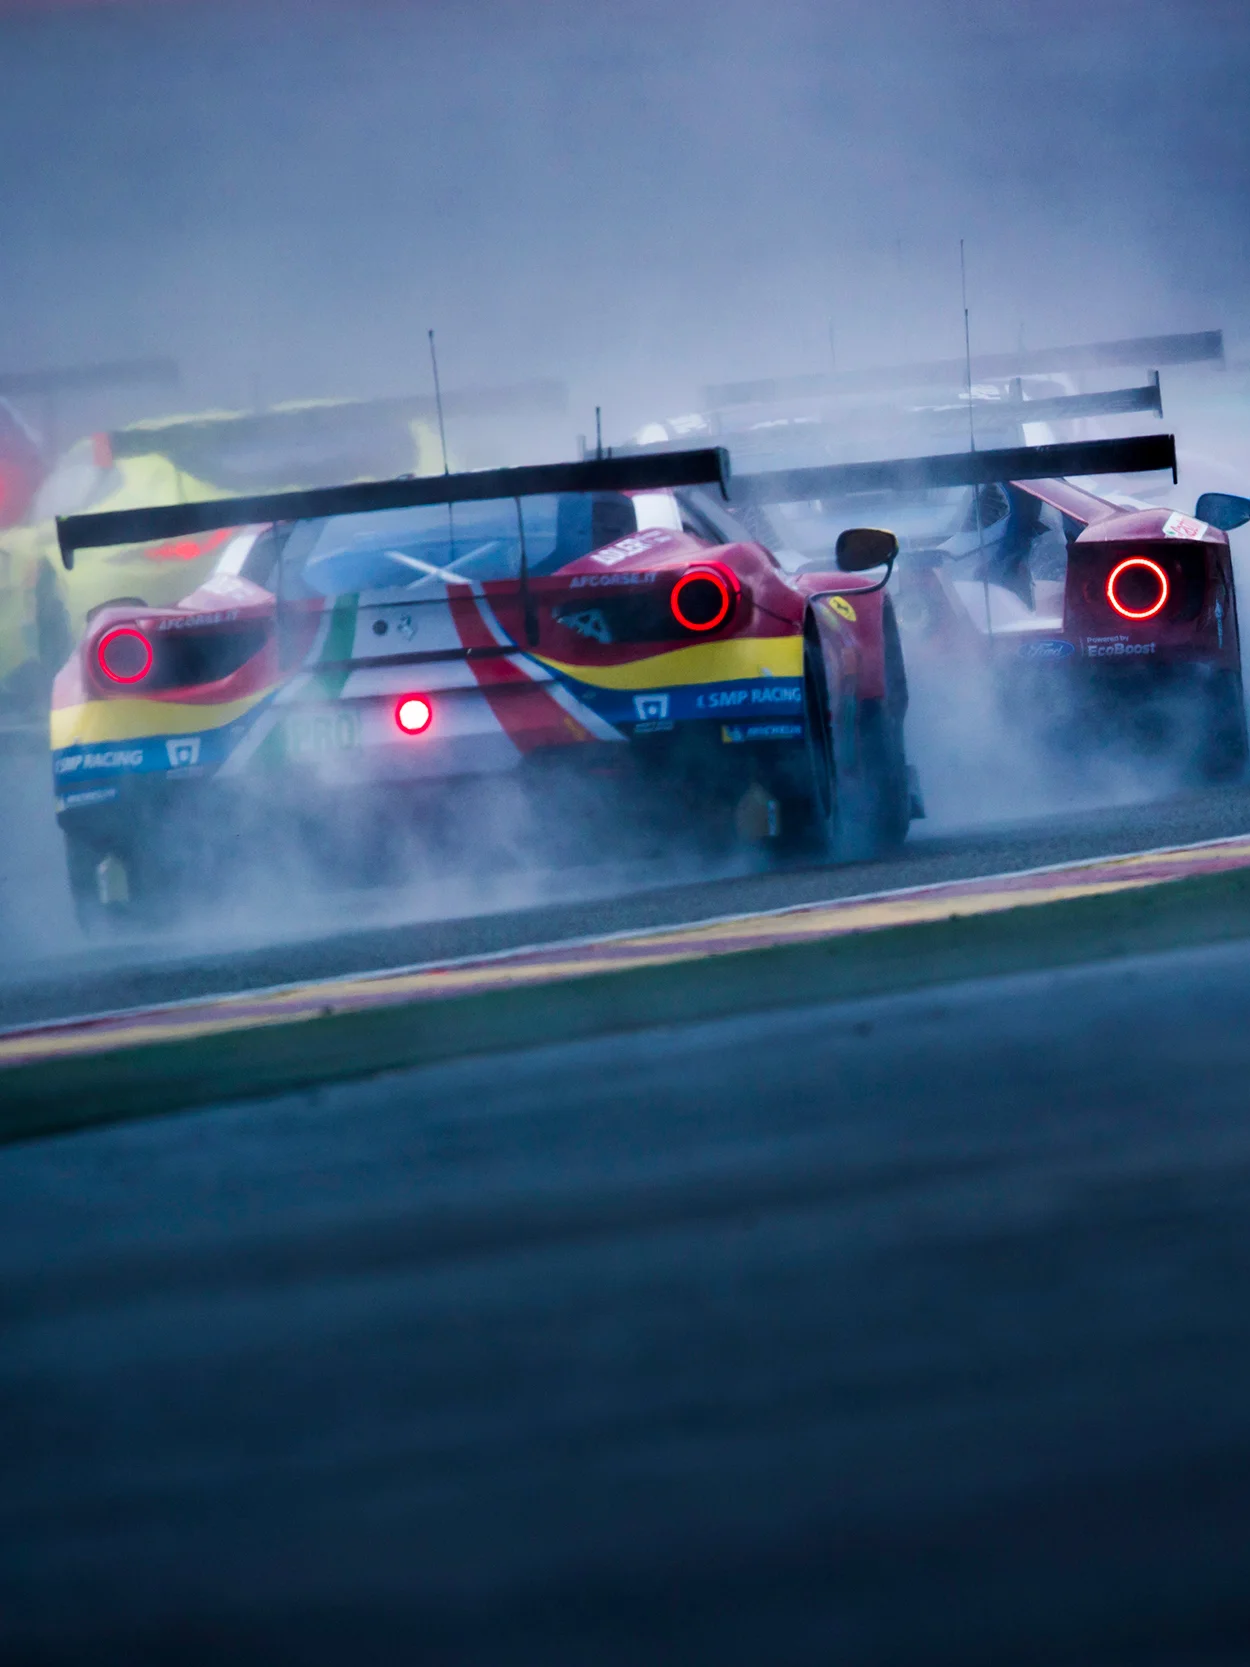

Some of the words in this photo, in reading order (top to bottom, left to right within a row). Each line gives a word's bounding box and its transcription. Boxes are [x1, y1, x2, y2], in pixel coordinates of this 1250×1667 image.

[1087, 642, 1156, 657] EcoBoost
[708, 690, 748, 708] SMP
[752, 687, 801, 703] RACING
